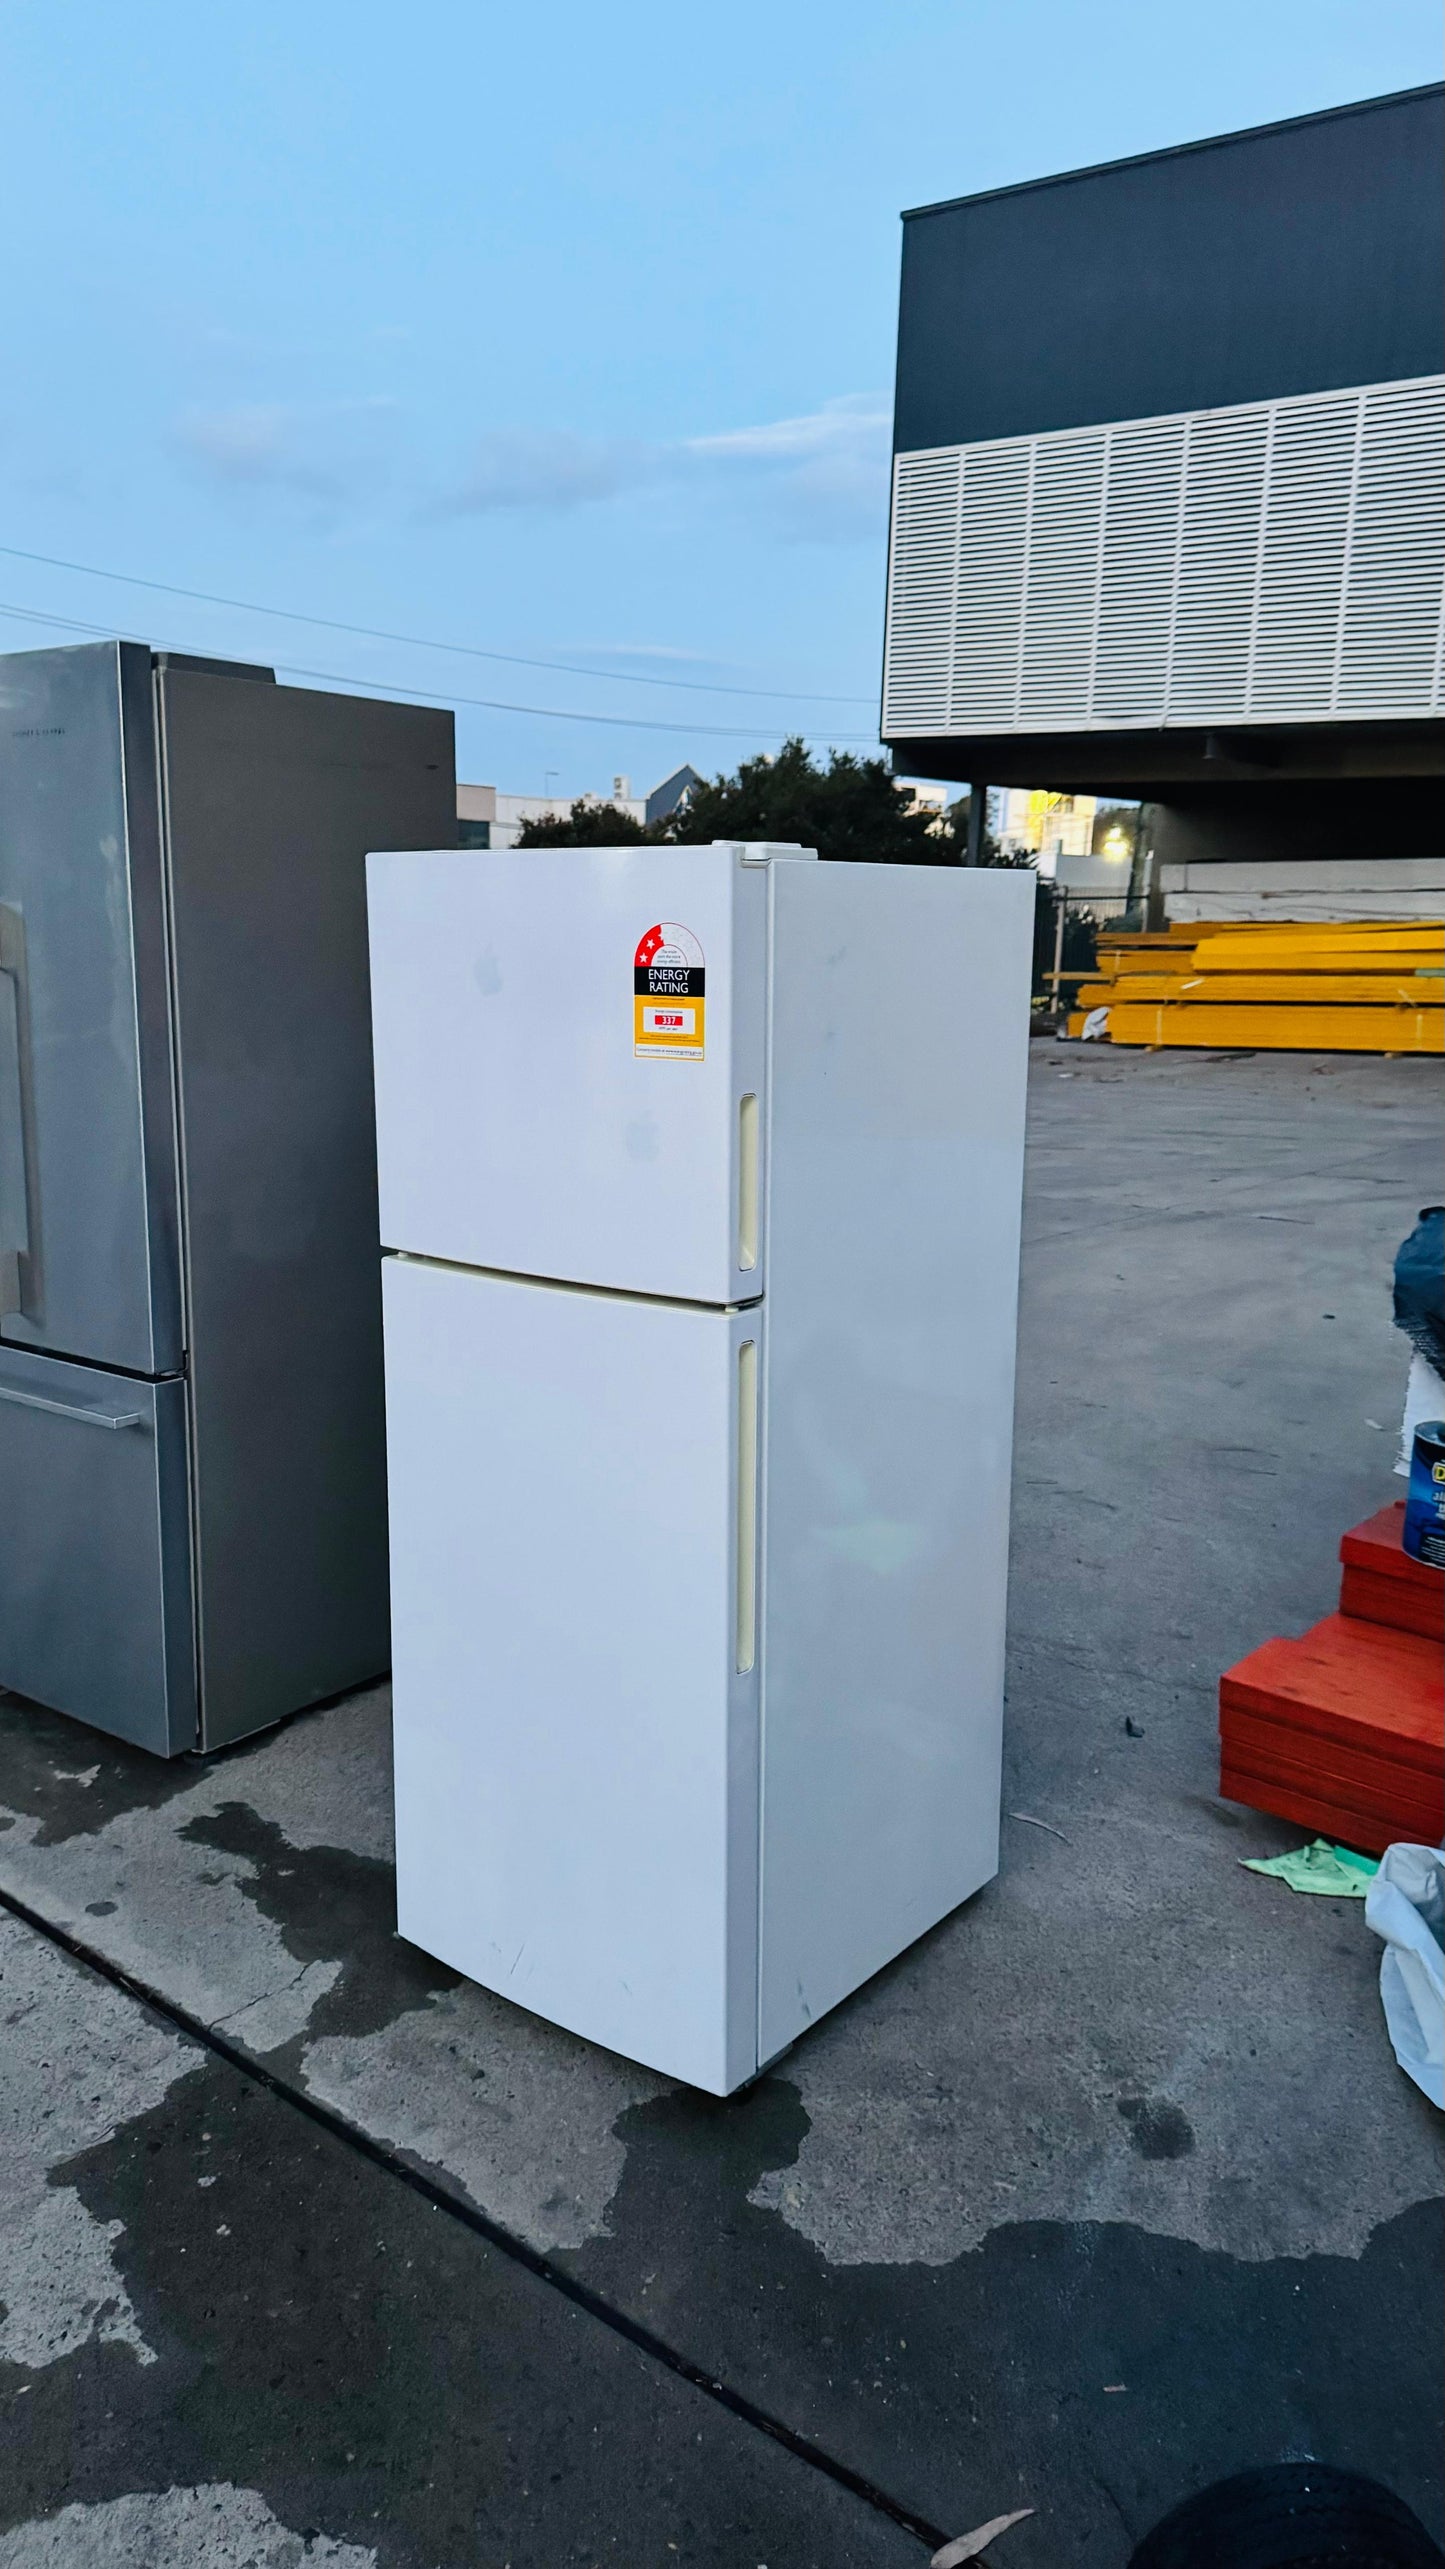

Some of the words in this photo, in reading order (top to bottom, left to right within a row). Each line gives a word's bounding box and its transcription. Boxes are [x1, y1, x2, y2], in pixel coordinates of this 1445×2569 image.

[648, 968, 690, 981] ENERGY
[649, 981, 689, 993] RATING
[662, 1016, 676, 1025] 337
